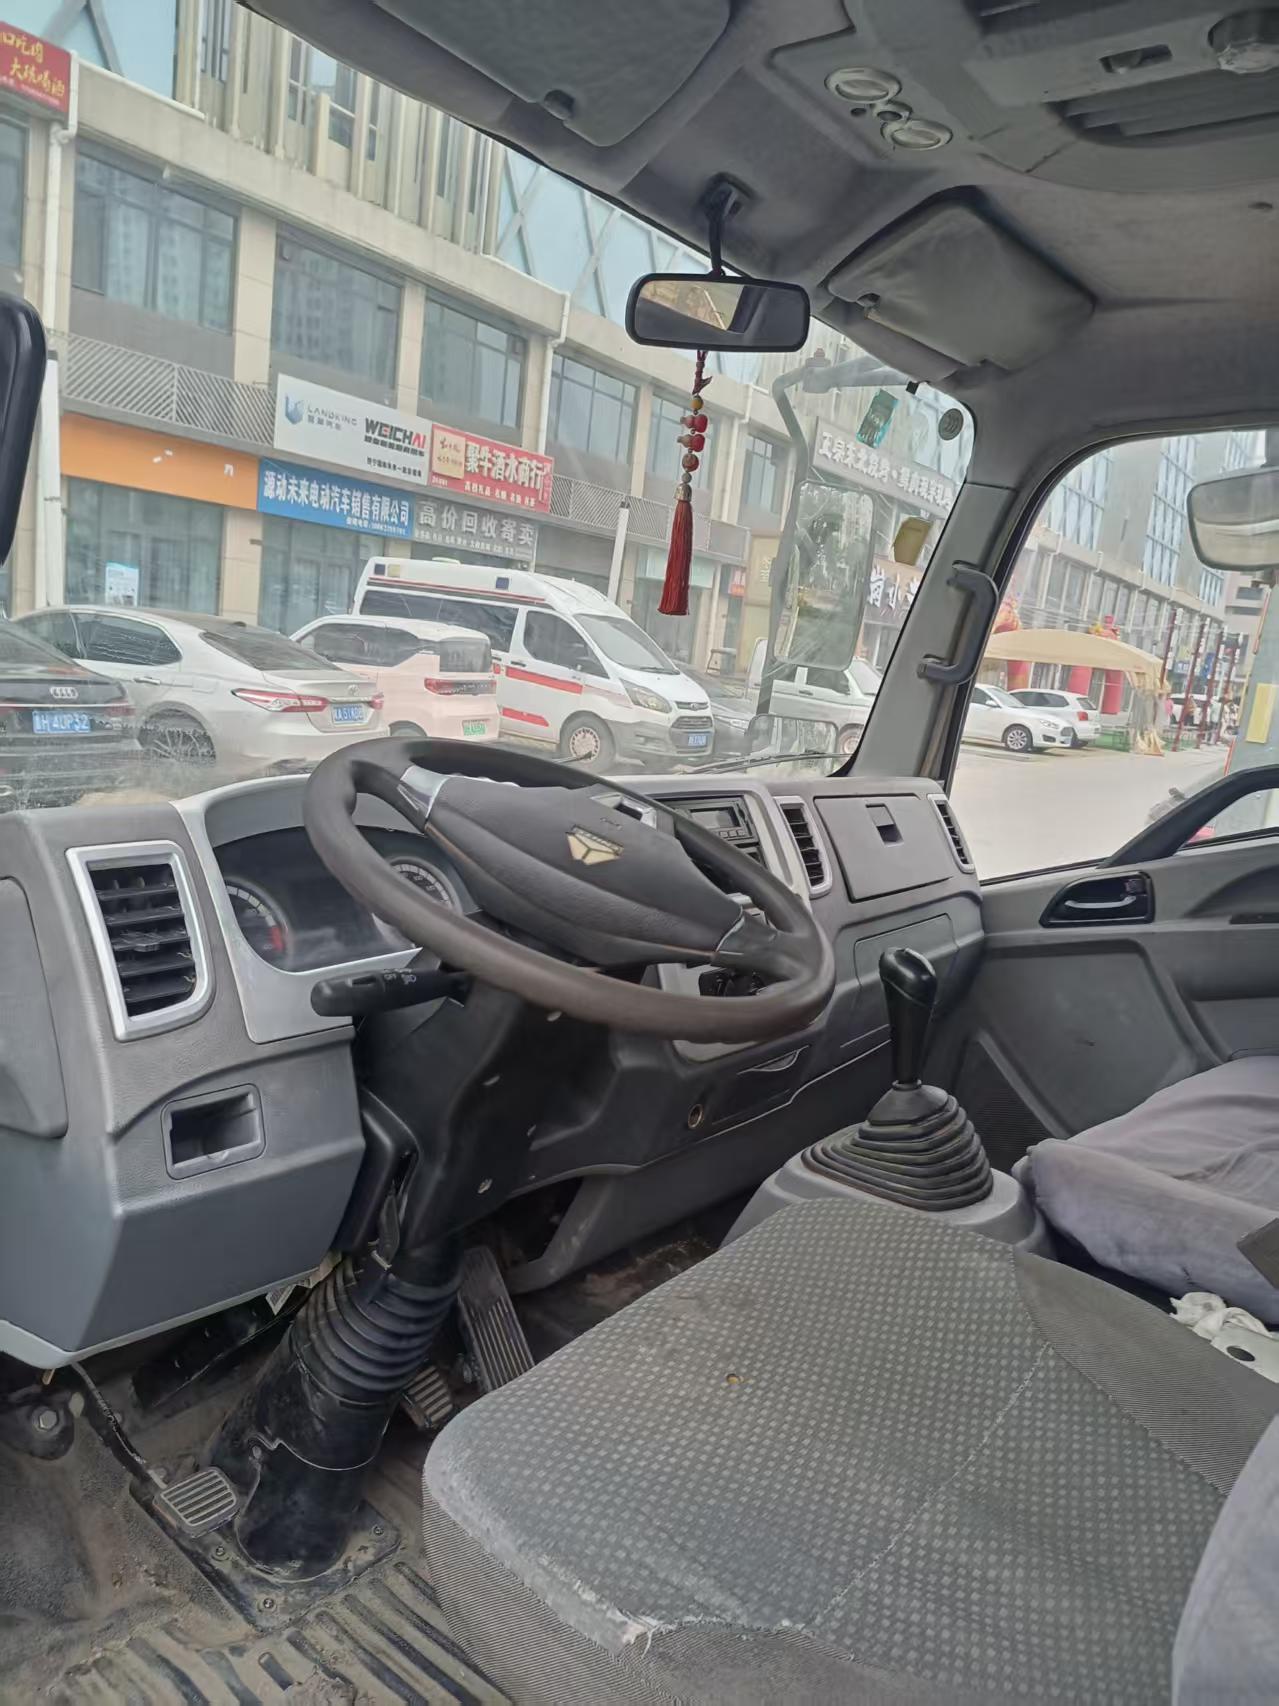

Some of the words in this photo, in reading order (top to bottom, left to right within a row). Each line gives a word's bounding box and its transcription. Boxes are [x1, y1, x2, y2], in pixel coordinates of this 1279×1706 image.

[364, 417, 427, 449] WEICHAI
[263, 470, 410, 526] 源动未来电动汽车销售有限公司
[416, 500, 535, 546] 高价回收寄卖
